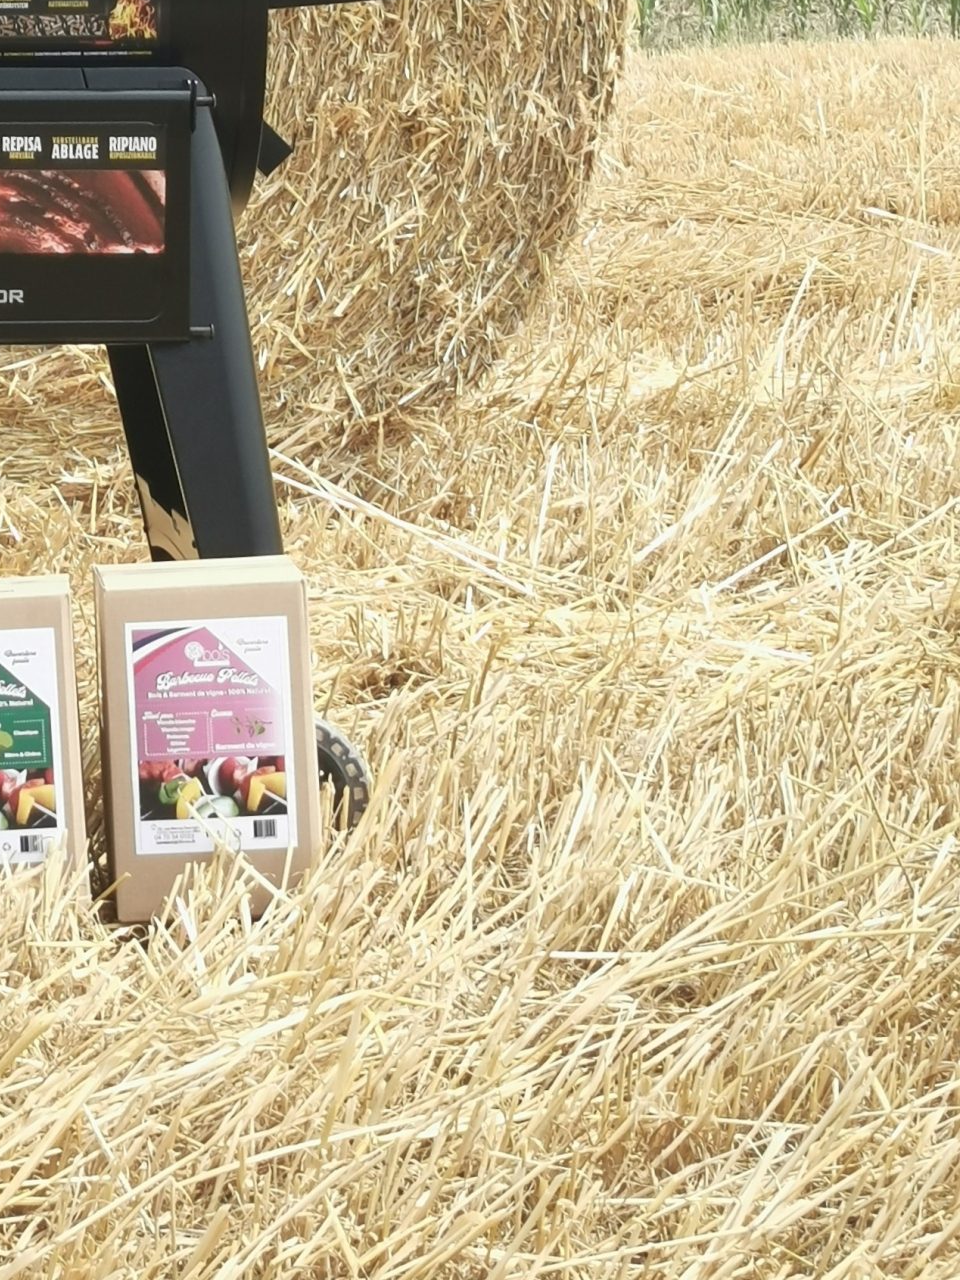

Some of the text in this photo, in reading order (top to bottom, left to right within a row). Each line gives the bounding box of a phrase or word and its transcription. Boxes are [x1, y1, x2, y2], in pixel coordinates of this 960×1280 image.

[2, 136, 42, 152] REPISA
[51, 143, 99, 160] ABLAGE
[109, 136, 157, 152] RIPIANO
[156, 668, 258, 690] Barbecue Pellets
[197, 689, 205, 697] de
[205, 689, 224, 698] vigne
[228, 688, 246, 696] 100%
